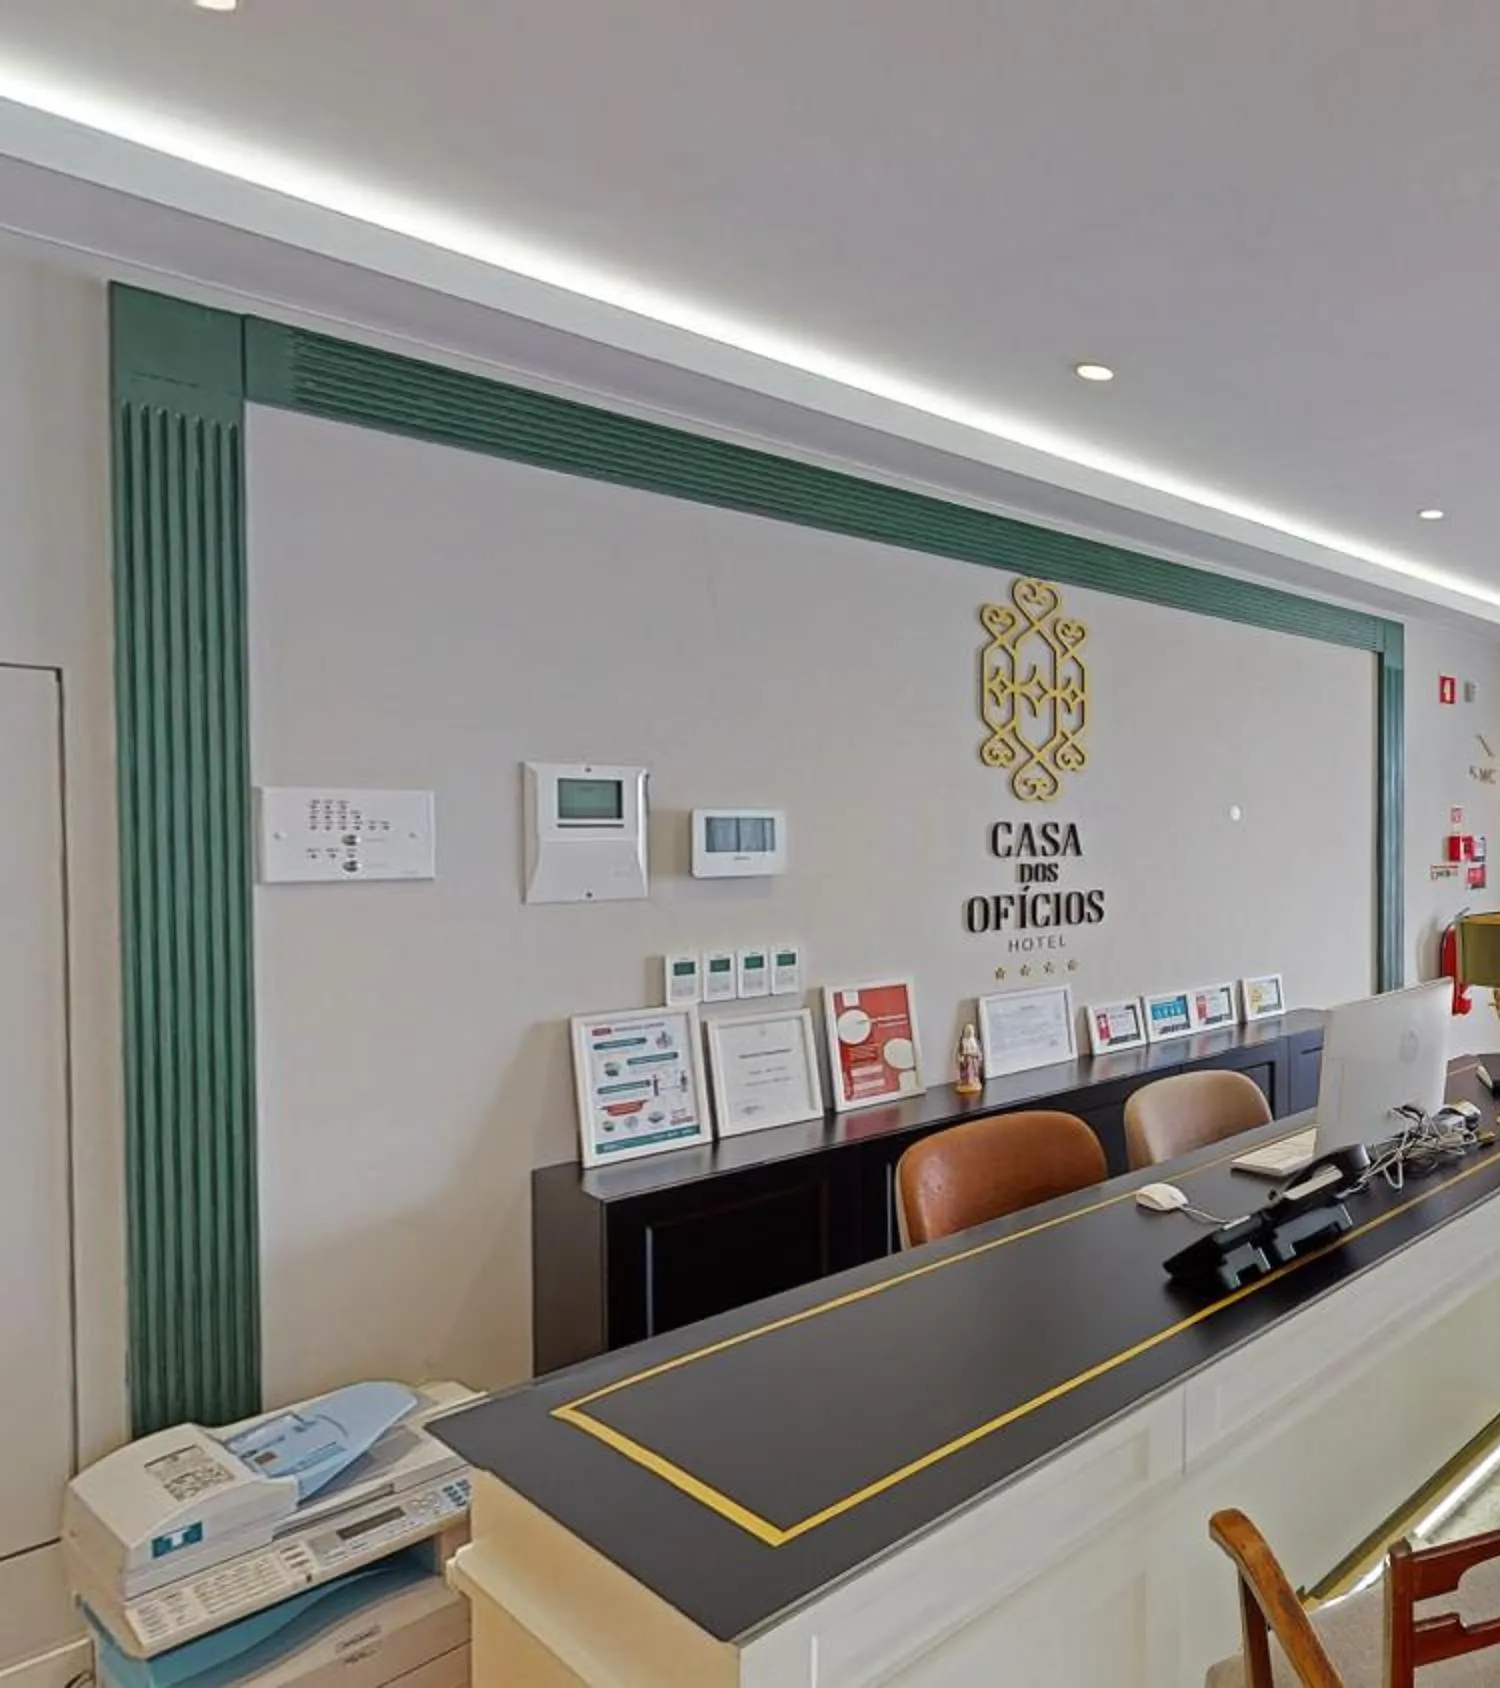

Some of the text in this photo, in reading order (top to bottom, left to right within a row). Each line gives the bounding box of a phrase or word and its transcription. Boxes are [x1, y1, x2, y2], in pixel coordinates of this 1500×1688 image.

[990, 821, 1083, 858] CASA
[1018, 862, 1060, 884] DOS
[966, 885, 1106, 933] OFÍCIOS
[1007, 934, 1067, 953] HOTEL
